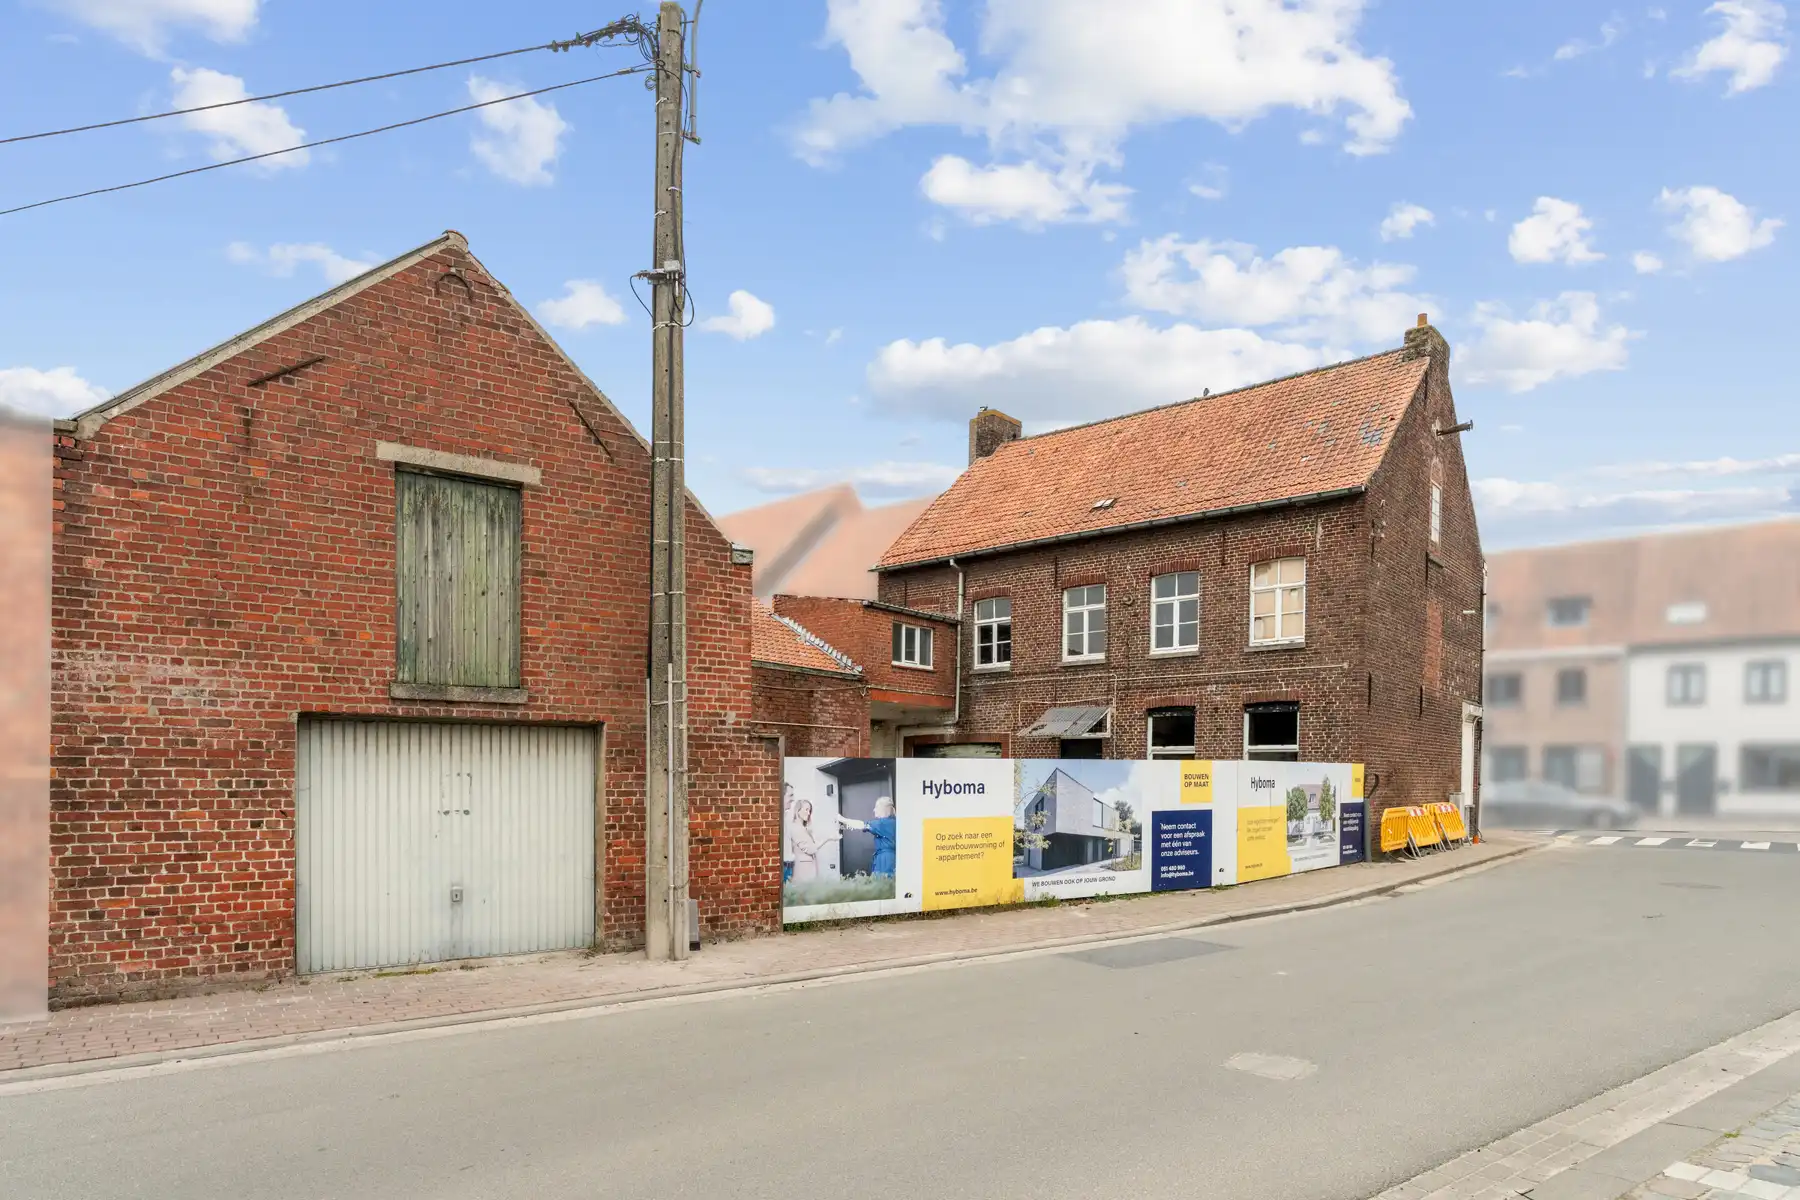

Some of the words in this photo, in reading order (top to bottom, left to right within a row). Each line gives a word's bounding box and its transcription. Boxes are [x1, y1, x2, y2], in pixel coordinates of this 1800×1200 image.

[1250, 776, 1276, 792] Hyboma
[922, 779, 985, 799] Hyboma
[935, 833, 946, 841] Op
[947, 832, 962, 840] zoek
[1184, 830, 1206, 839] afspraak
[935, 842, 997, 851] nieuwbouwwoning
[935, 852, 985, 862] -appartement?
[934, 888, 978, 896] www.hyboma.be
